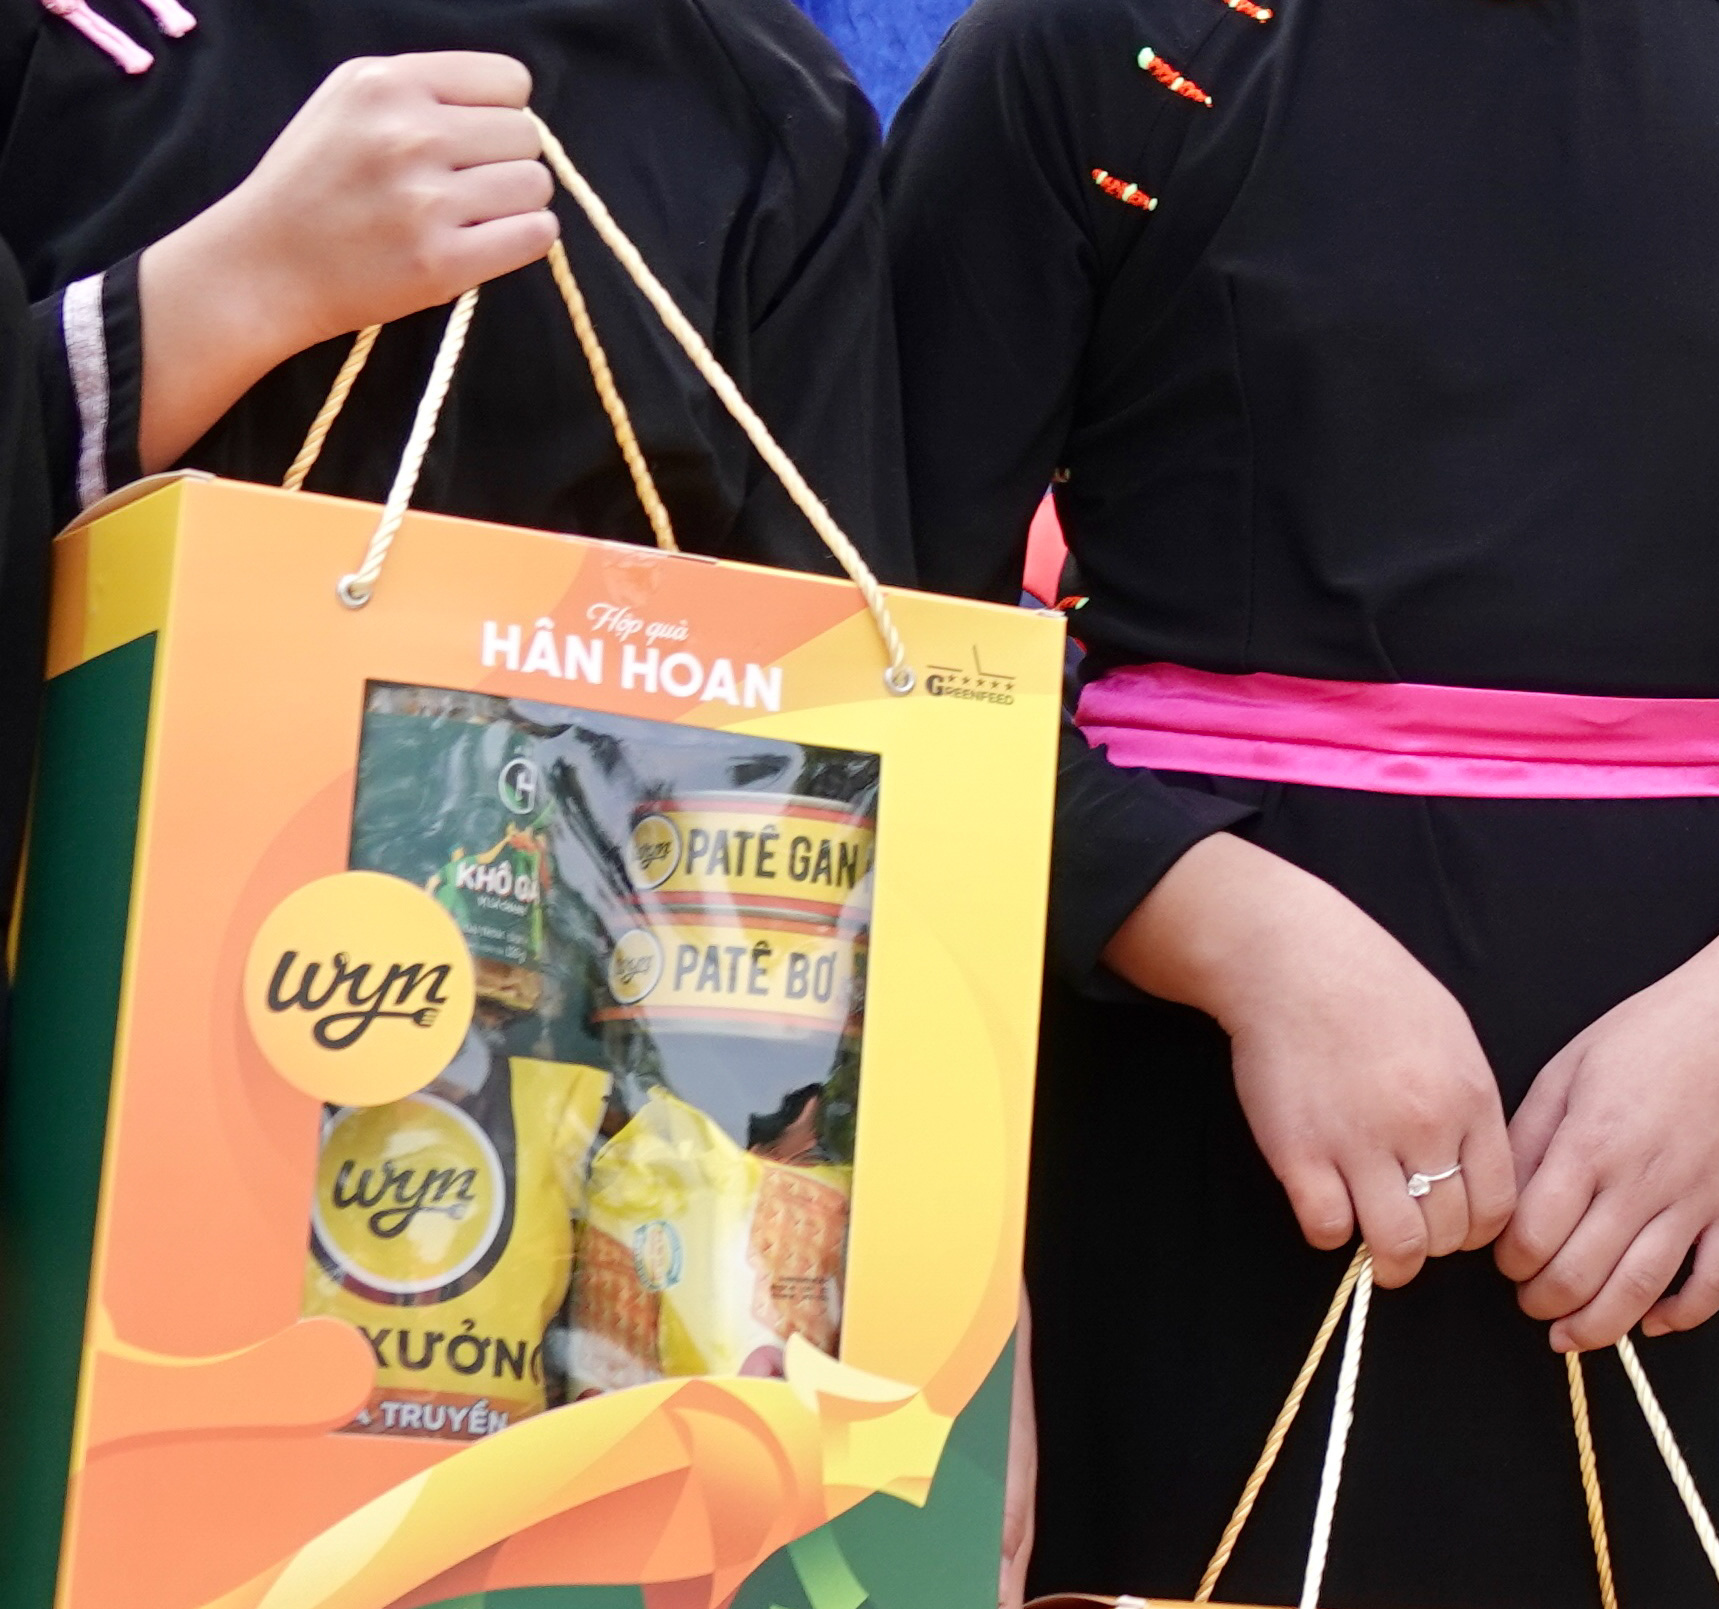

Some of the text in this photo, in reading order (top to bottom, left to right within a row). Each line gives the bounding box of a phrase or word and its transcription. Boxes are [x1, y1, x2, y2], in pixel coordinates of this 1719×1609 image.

[586, 603, 642, 642] Hộp
[481, 616, 783, 712] HÂN HOAN
[456, 860, 512, 897] KHÔ
[685, 824, 858, 889] PATÊ GAN
[267, 950, 452, 1050] wyn
[673, 940, 772, 995] PATÊ
[331, 1158, 478, 1238] wyn
